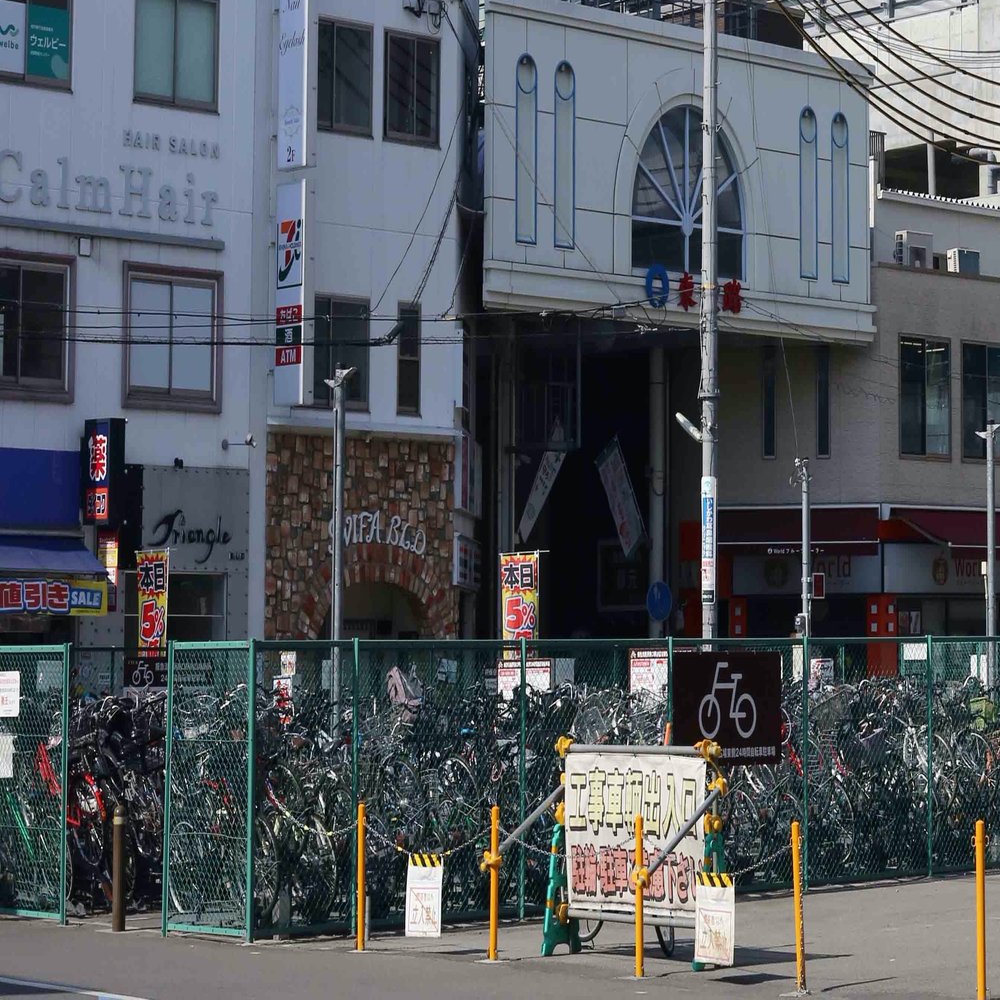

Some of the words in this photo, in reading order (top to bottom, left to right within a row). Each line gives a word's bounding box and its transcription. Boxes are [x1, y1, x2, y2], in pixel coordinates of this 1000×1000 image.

[30, 34, 66, 50] ウェルビー
[123, 129, 160, 151] HAIR
[168, 135, 220, 160] SALON
[286, 146, 296, 163] 2F
[280, 349, 297, 363] ATM
[89, 435, 108, 482] 薬
[140, 561, 165, 593] 本日
[503, 562, 534, 590] 本日
[71, 591, 101, 606] SALE
[140, 600, 165, 640] 5%
[505, 597, 536, 631] 5%
